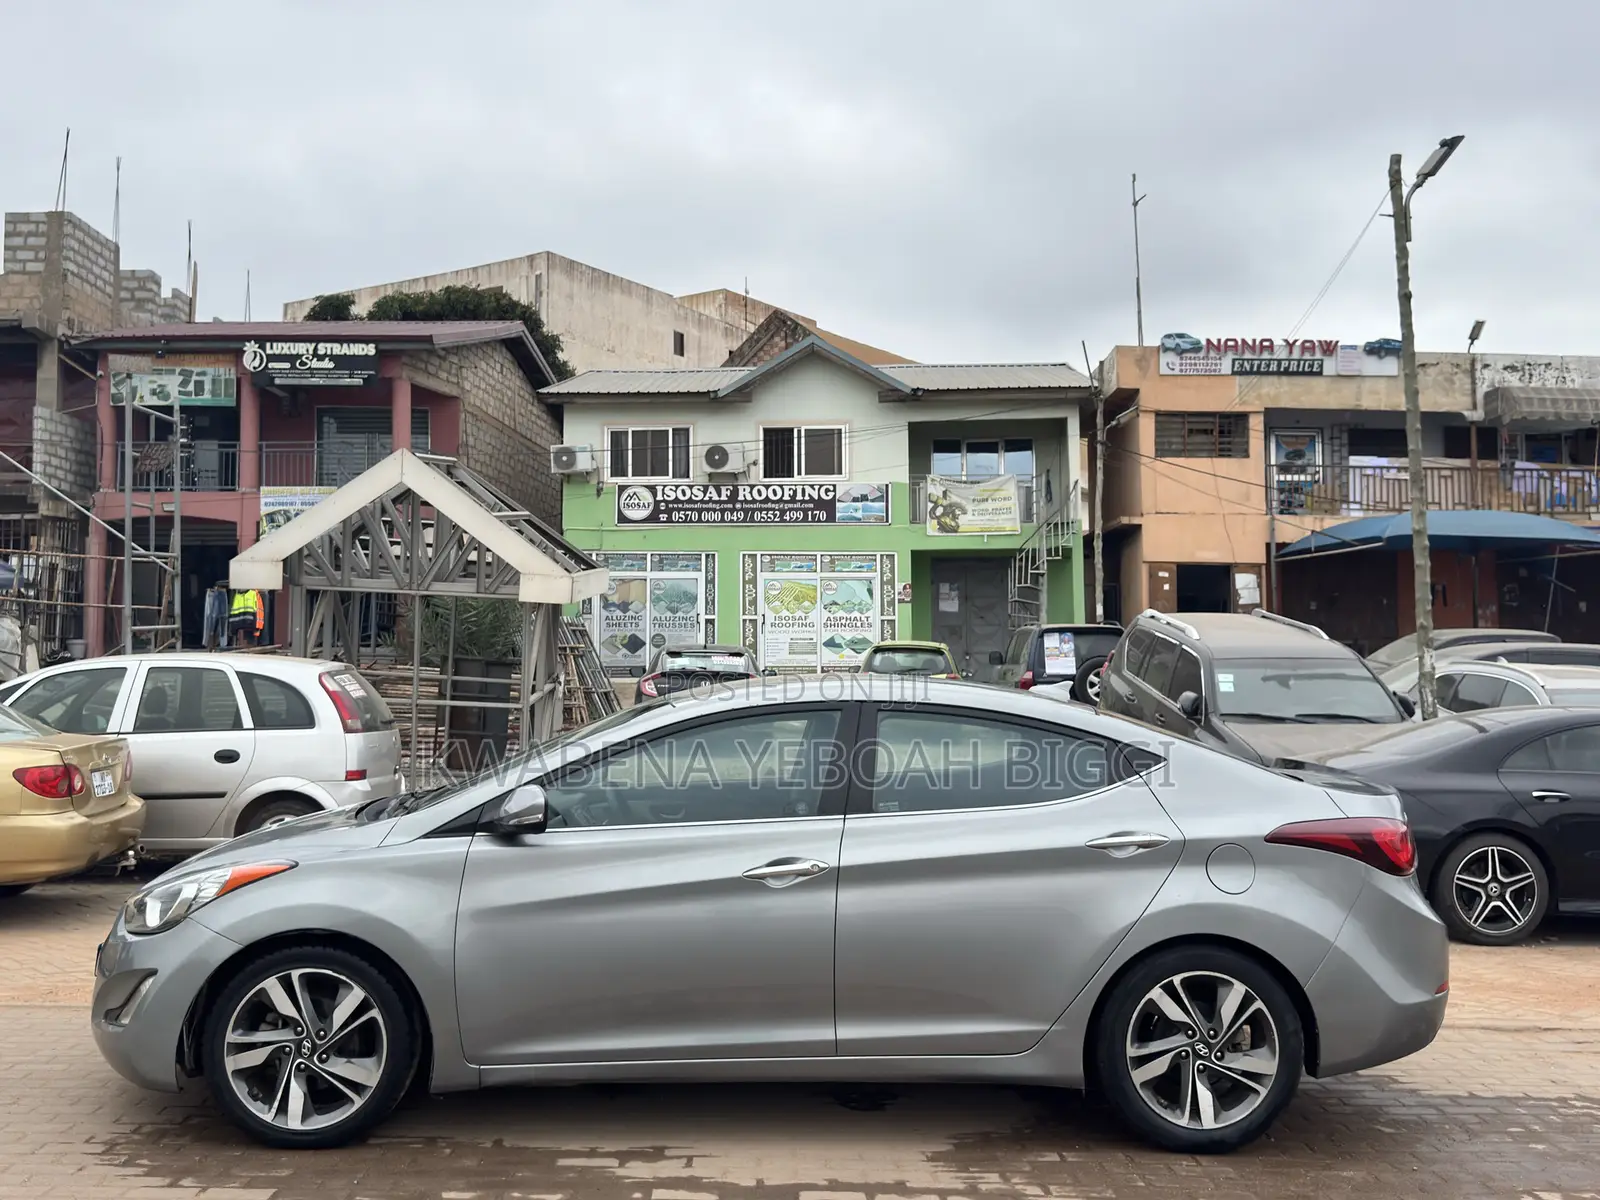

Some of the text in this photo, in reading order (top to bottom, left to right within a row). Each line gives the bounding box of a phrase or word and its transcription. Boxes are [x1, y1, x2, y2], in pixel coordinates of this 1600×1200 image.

[265, 342, 377, 356] LUXURY STRANDS
[1204, 338, 1340, 356] NANA YAW
[295, 354, 336, 370] Studio
[655, 485, 835, 501] ISOSAF ROOFING
[622, 501, 652, 509] ISOSAF
[671, 511, 699, 522] 0570
[701, 511, 721, 522] 000
[724, 511, 744, 522] 049
[753, 510, 780, 522] 0552
[783, 510, 803, 522] 499
[807, 510, 827, 522] 170
